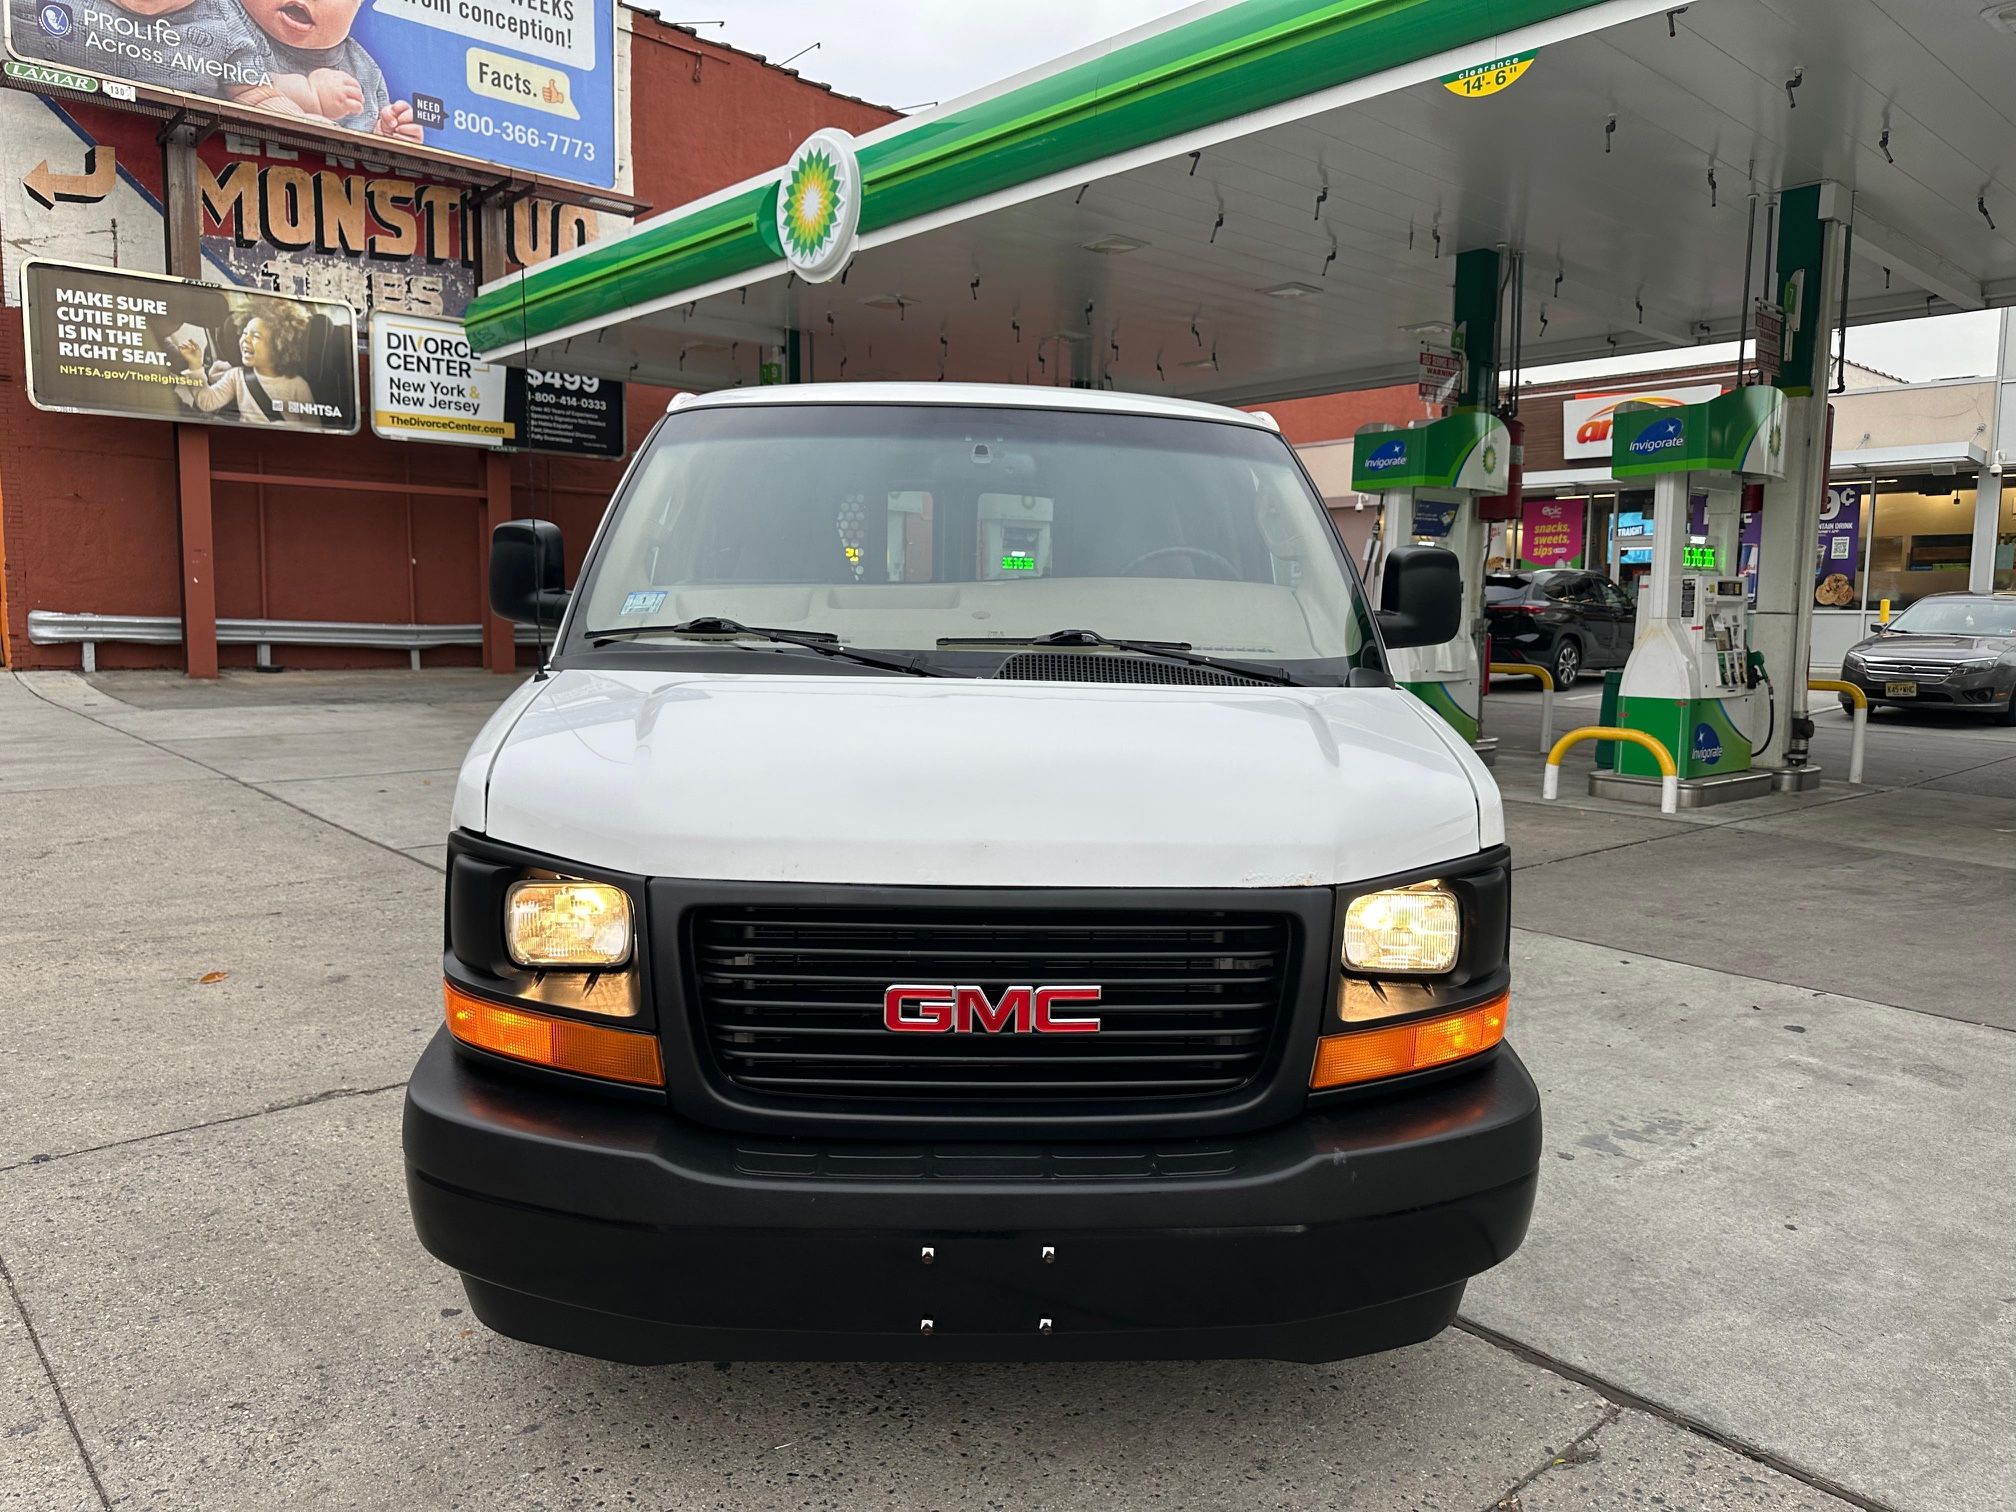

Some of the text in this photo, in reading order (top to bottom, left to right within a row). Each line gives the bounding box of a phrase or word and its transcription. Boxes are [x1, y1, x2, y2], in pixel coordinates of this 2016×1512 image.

[458, 1, 572, 49] conception!
[85, 31, 163, 64] Across
[12, 65, 89, 89] LAMAR
[478, 61, 538, 98] Facts.
[1458, 57, 1519, 80] clearance
[416, 98, 440, 113] NEED
[416, 109, 442, 124] HELP?
[453, 109, 596, 162] 800-366-7773
[197, 158, 599, 267] MONSTUO
[55, 287, 168, 315] MAKE SURE
[56, 306, 147, 330] CUTIE PIE
[58, 323, 143, 347] IS IN THE
[58, 341, 172, 367] RIGHT SEAT.
[386, 352, 472, 378] CENTER
[59, 364, 204, 387] NHTSA.gov/TheRightSeat
[389, 376, 480, 399] New York &
[299, 402, 343, 418] NHTSA
[389, 391, 480, 416] New Jersey
[528, 390, 607, 411] 1-800-414-0333
[389, 415, 506, 435] TheDivorceCenter.com
[1629, 437, 1684, 452] Invigorate
[1364, 456, 1407, 469] Invigorate
[1534, 522, 1570, 533] snacks,
[1534, 533, 1570, 545] sweets,
[1618, 526, 1643, 536] TRAIGHT
[1533, 546, 1553, 558] sips
[1692, 746, 1723, 762] Invigorate
[883, 983, 1103, 1033] GMC
